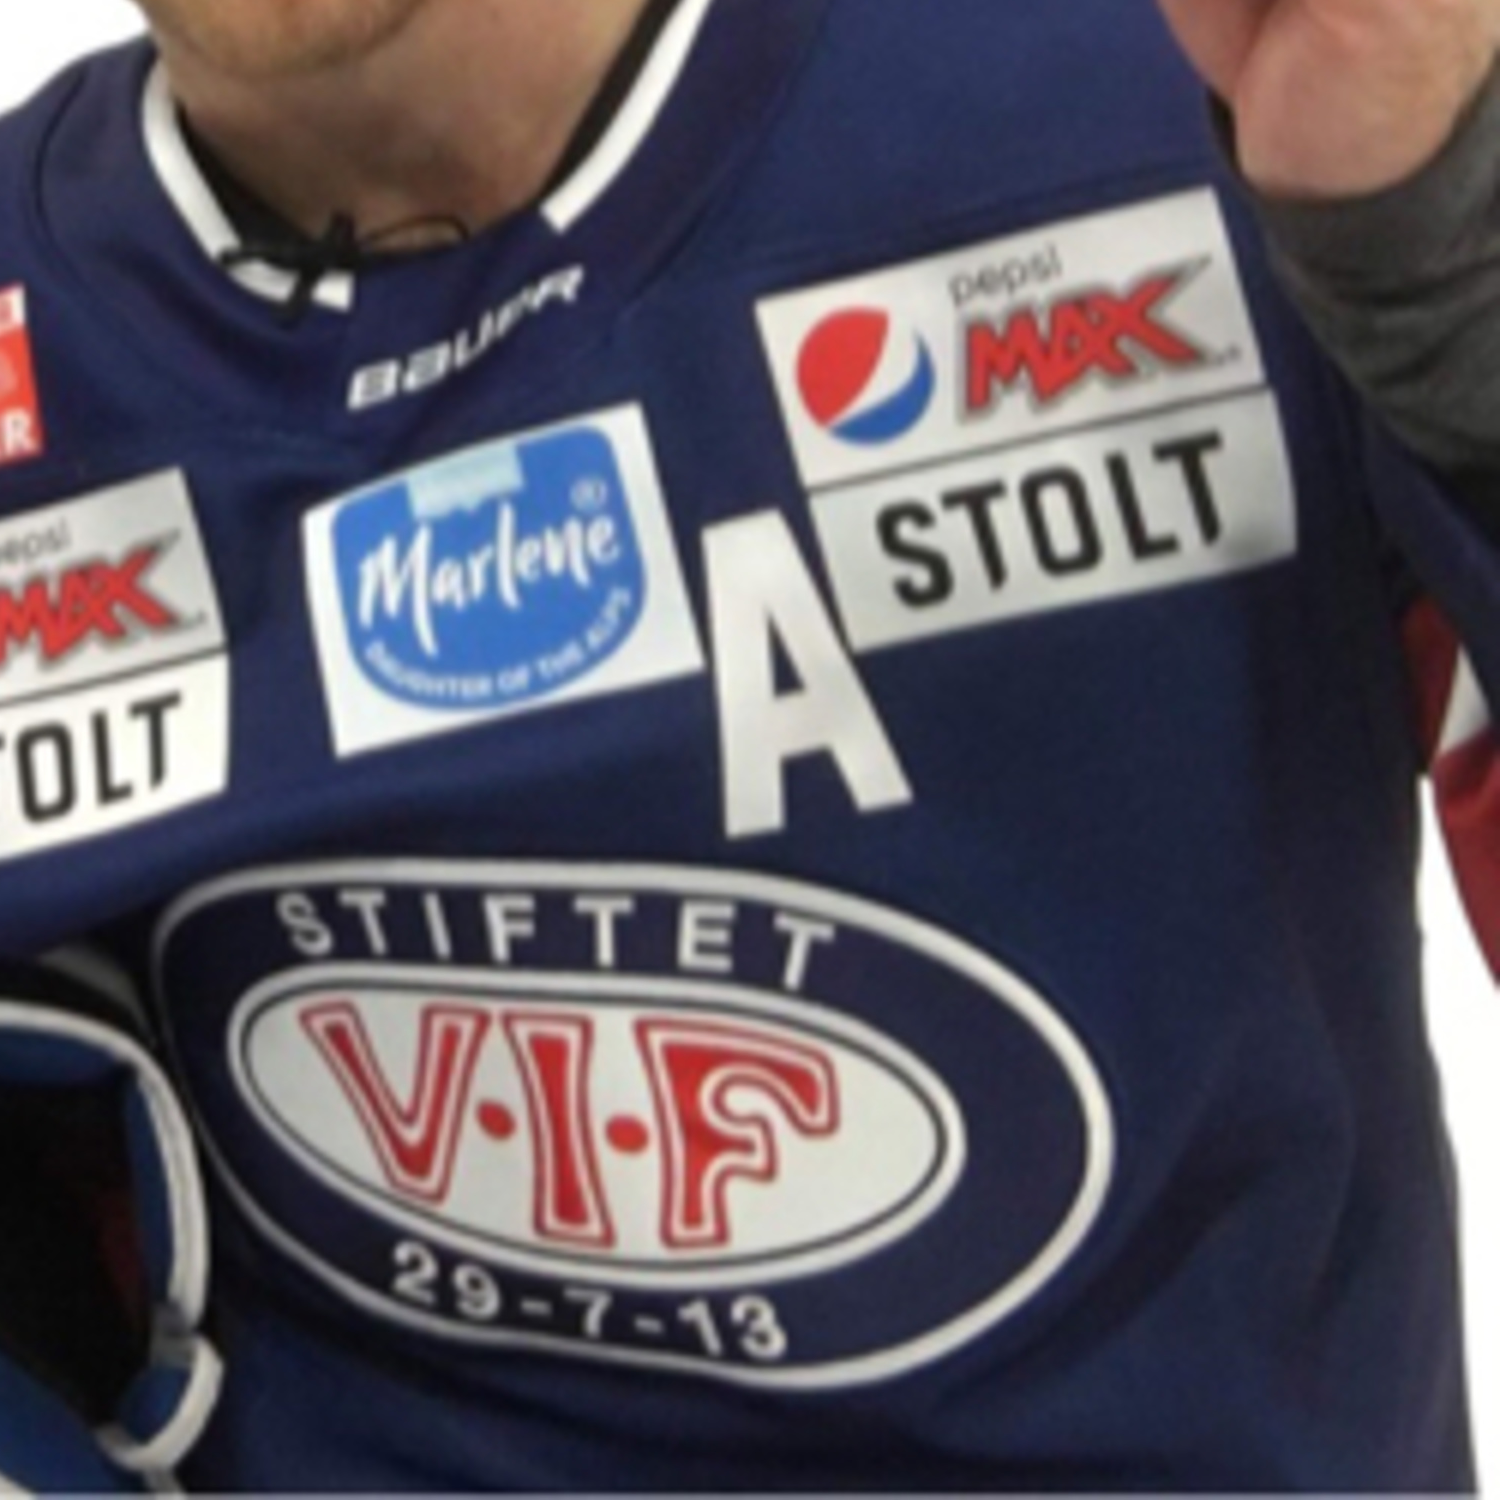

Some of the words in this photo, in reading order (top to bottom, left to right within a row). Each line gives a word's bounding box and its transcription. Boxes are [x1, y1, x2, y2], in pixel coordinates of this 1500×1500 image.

[947, 243, 1063, 307] pepsi
[957, 253, 1213, 425] MAX
[357, 501, 620, 658] Marlene
[874, 428, 1222, 611] STOLT
[701, 506, 915, 841] A
[276, 889, 834, 989] STIFTET
[393, 1240, 787, 1360] 29-7-13
